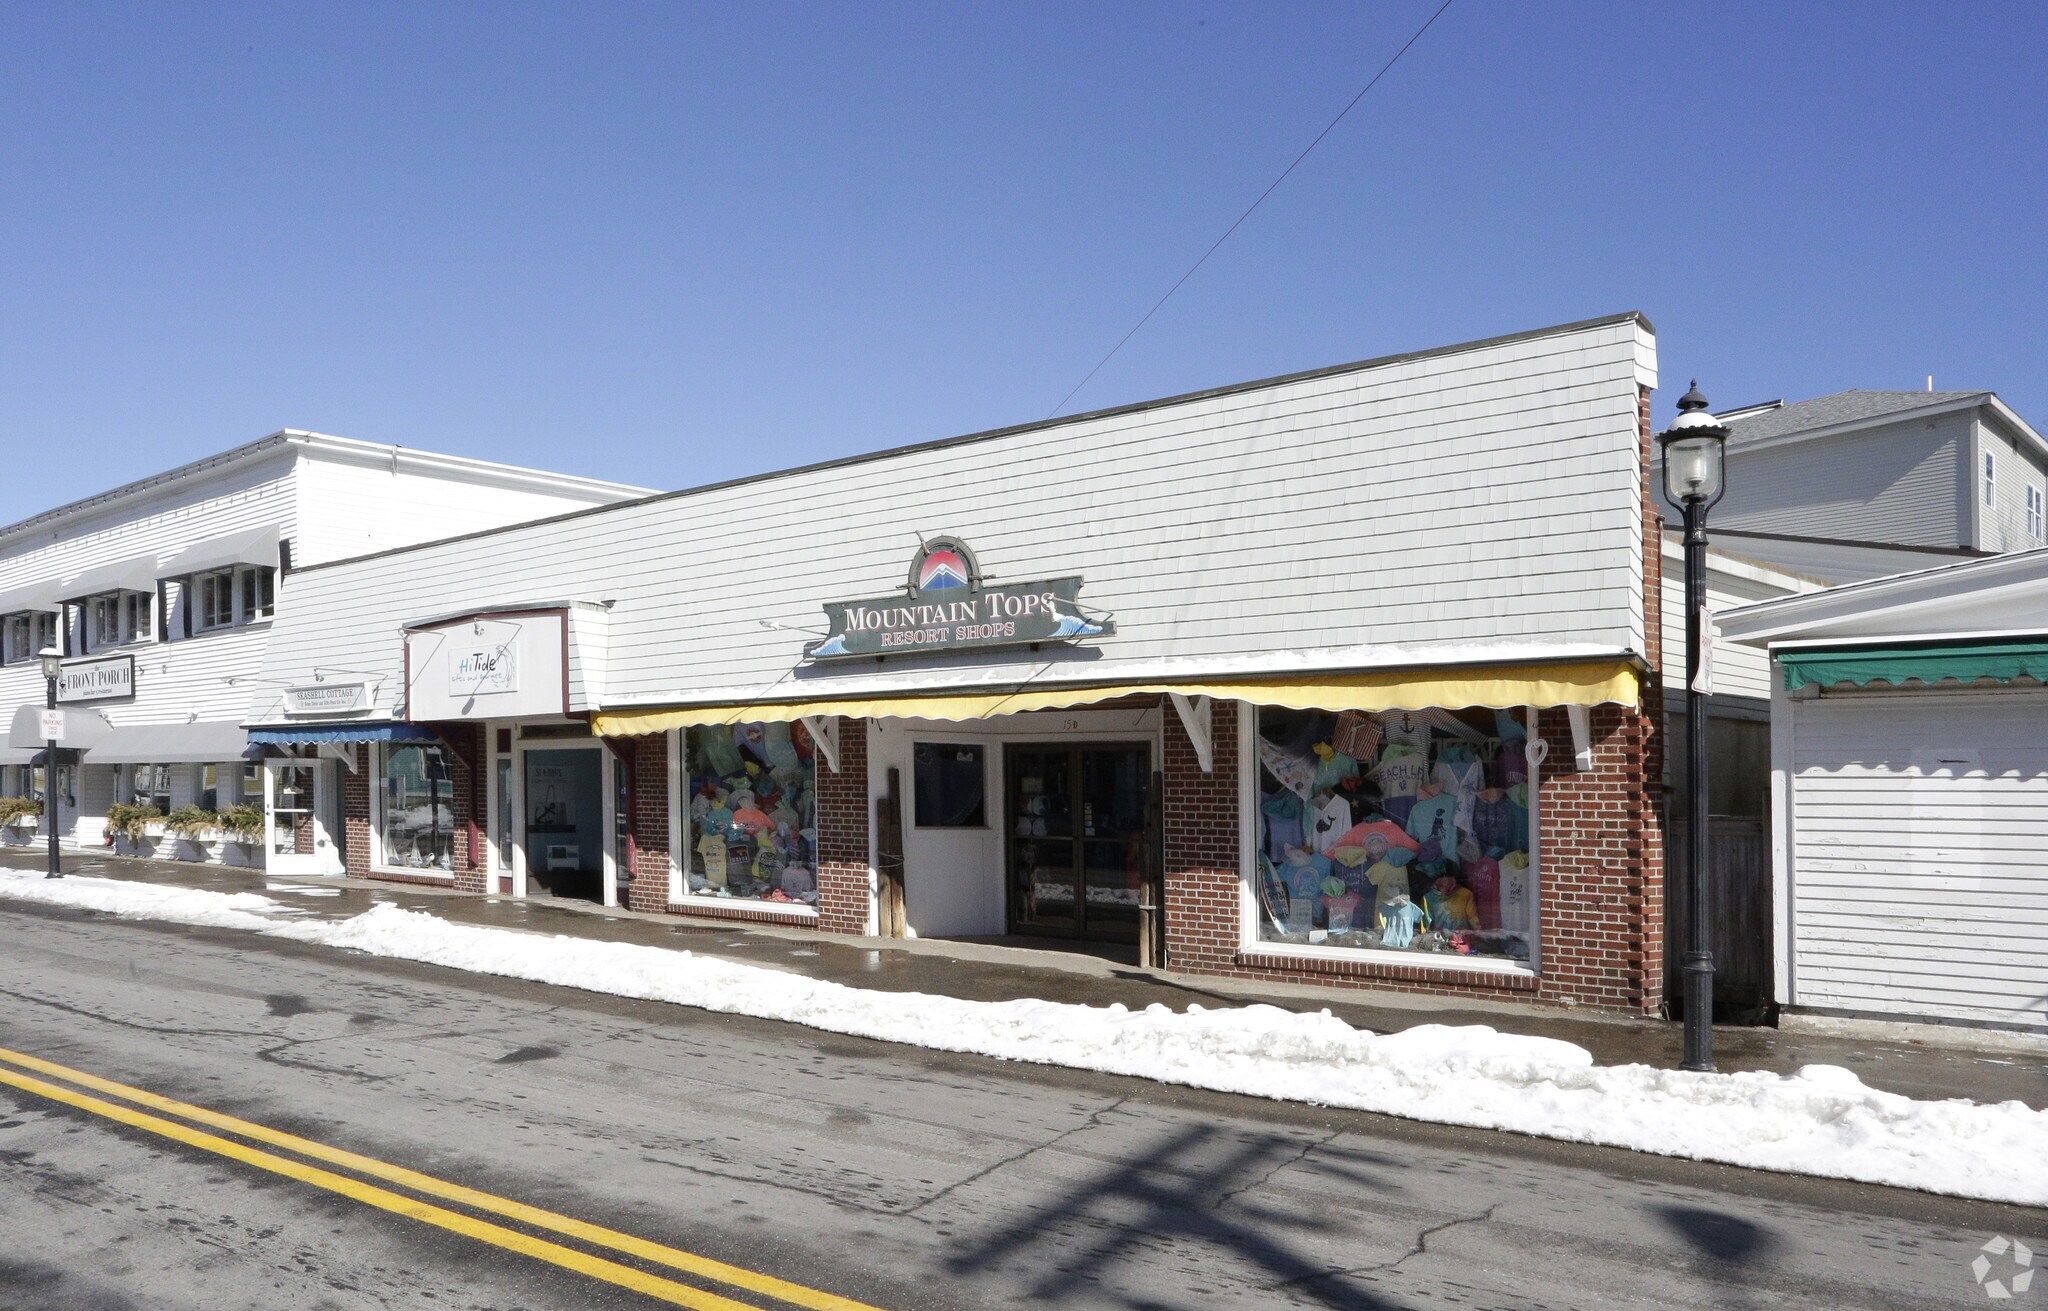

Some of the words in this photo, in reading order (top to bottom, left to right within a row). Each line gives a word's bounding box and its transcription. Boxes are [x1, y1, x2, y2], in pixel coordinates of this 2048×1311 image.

[844, 601, 978, 632] MOUNTAIN
[985, 592, 1056, 619] TOPS
[881, 628, 950, 647] RESORT
[955, 621, 1016, 641] SHOPS
[67, 672, 96, 689] FRONT
[98, 668, 130, 686] PORCH
[297, 691, 325, 700] SEASHELL
[327, 689, 353, 698] COTTAGE
